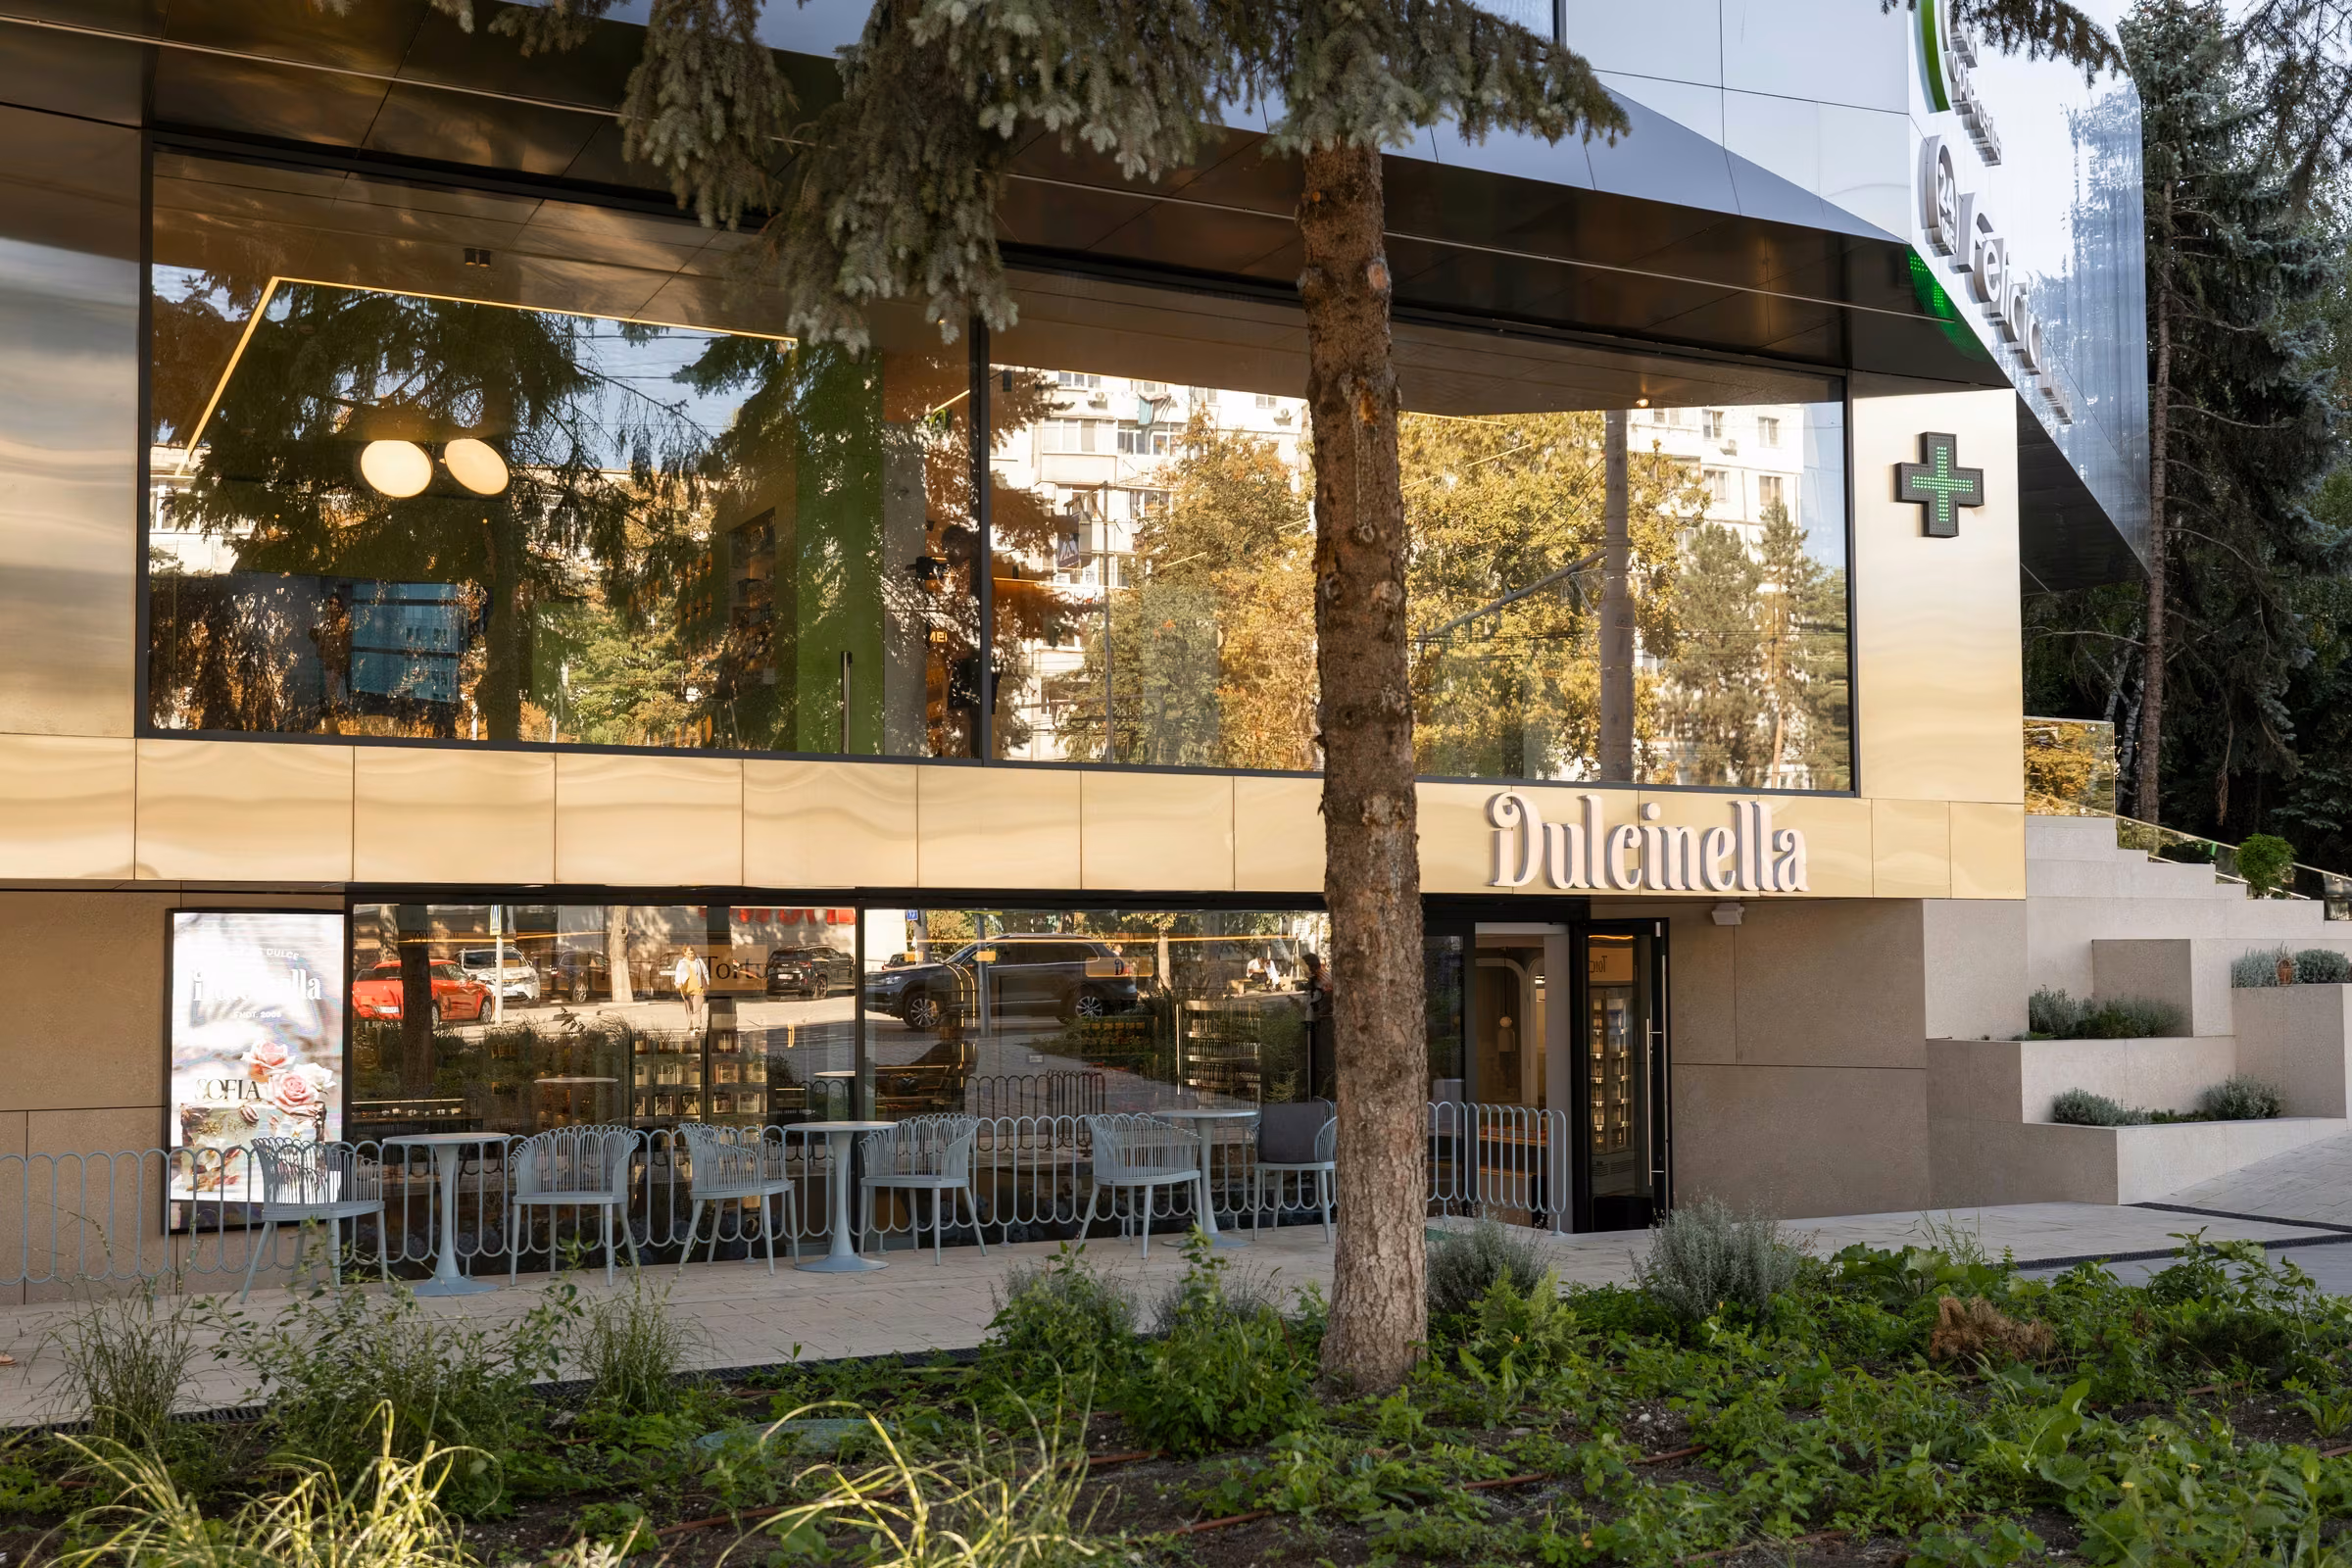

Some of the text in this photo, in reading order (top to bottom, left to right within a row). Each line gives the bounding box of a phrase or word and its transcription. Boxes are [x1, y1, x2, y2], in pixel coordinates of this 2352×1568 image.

[1937, 161, 1956, 224] 24
[1486, 791, 1810, 893] Dulcinella
[266, 948, 299, 960] DULCE
[195, 1079, 262, 1100] SOFIA
